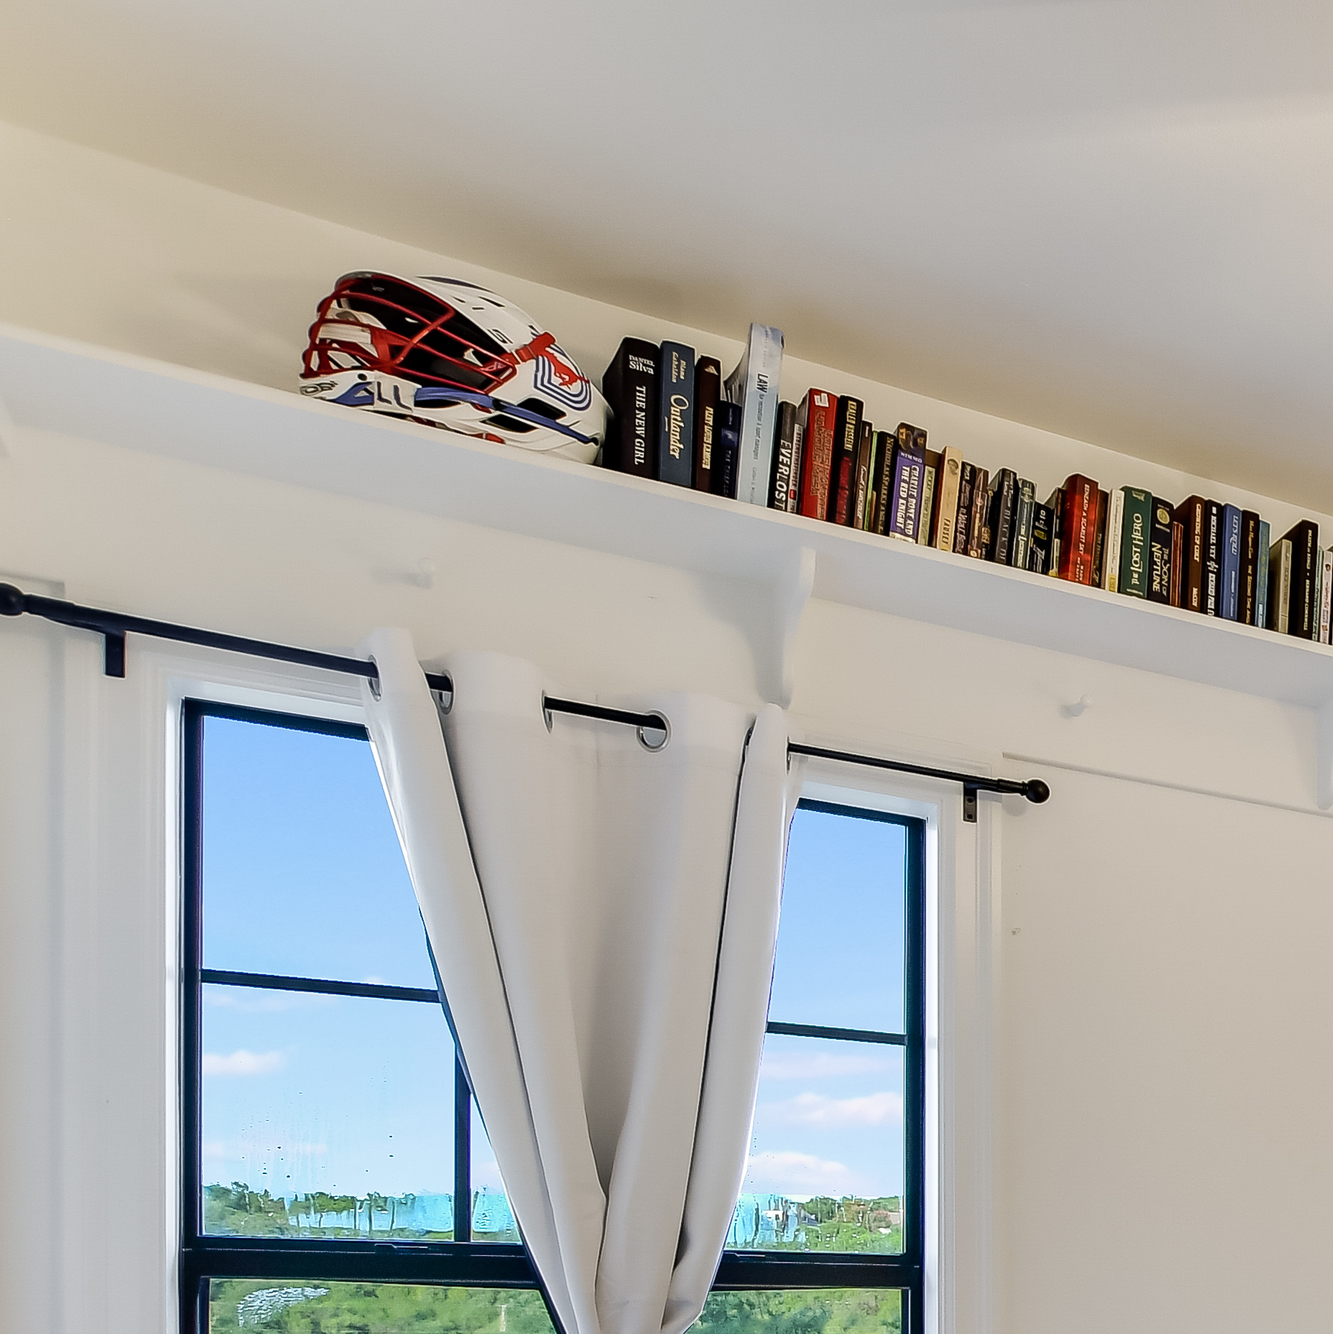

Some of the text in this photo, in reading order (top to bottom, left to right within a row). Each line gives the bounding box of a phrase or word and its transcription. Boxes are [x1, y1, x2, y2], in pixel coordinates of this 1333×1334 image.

[628, 360, 655, 375] Silva
[756, 372, 770, 394] LAW
[633, 385, 647, 466] THE NEW GIRL
[669, 394, 689, 460] Outlander
[883, 436, 894, 475] NICHOLAS
[774, 439, 793, 511] EVERLOST
[880, 476, 891, 504] SPARKS
[896, 465, 910, 529] THE RED KNIGHT
[904, 464, 920, 536] CHARLIE BONE AND
[942, 517, 951, 545] FAUSET
[1079, 517, 1087, 543] SCARLET
[1131, 513, 1144, 546] HERO
[1130, 545, 1144, 572] LOST
[1151, 541, 1162, 592] NEPTUNE
[1161, 560, 1170, 585] SON
